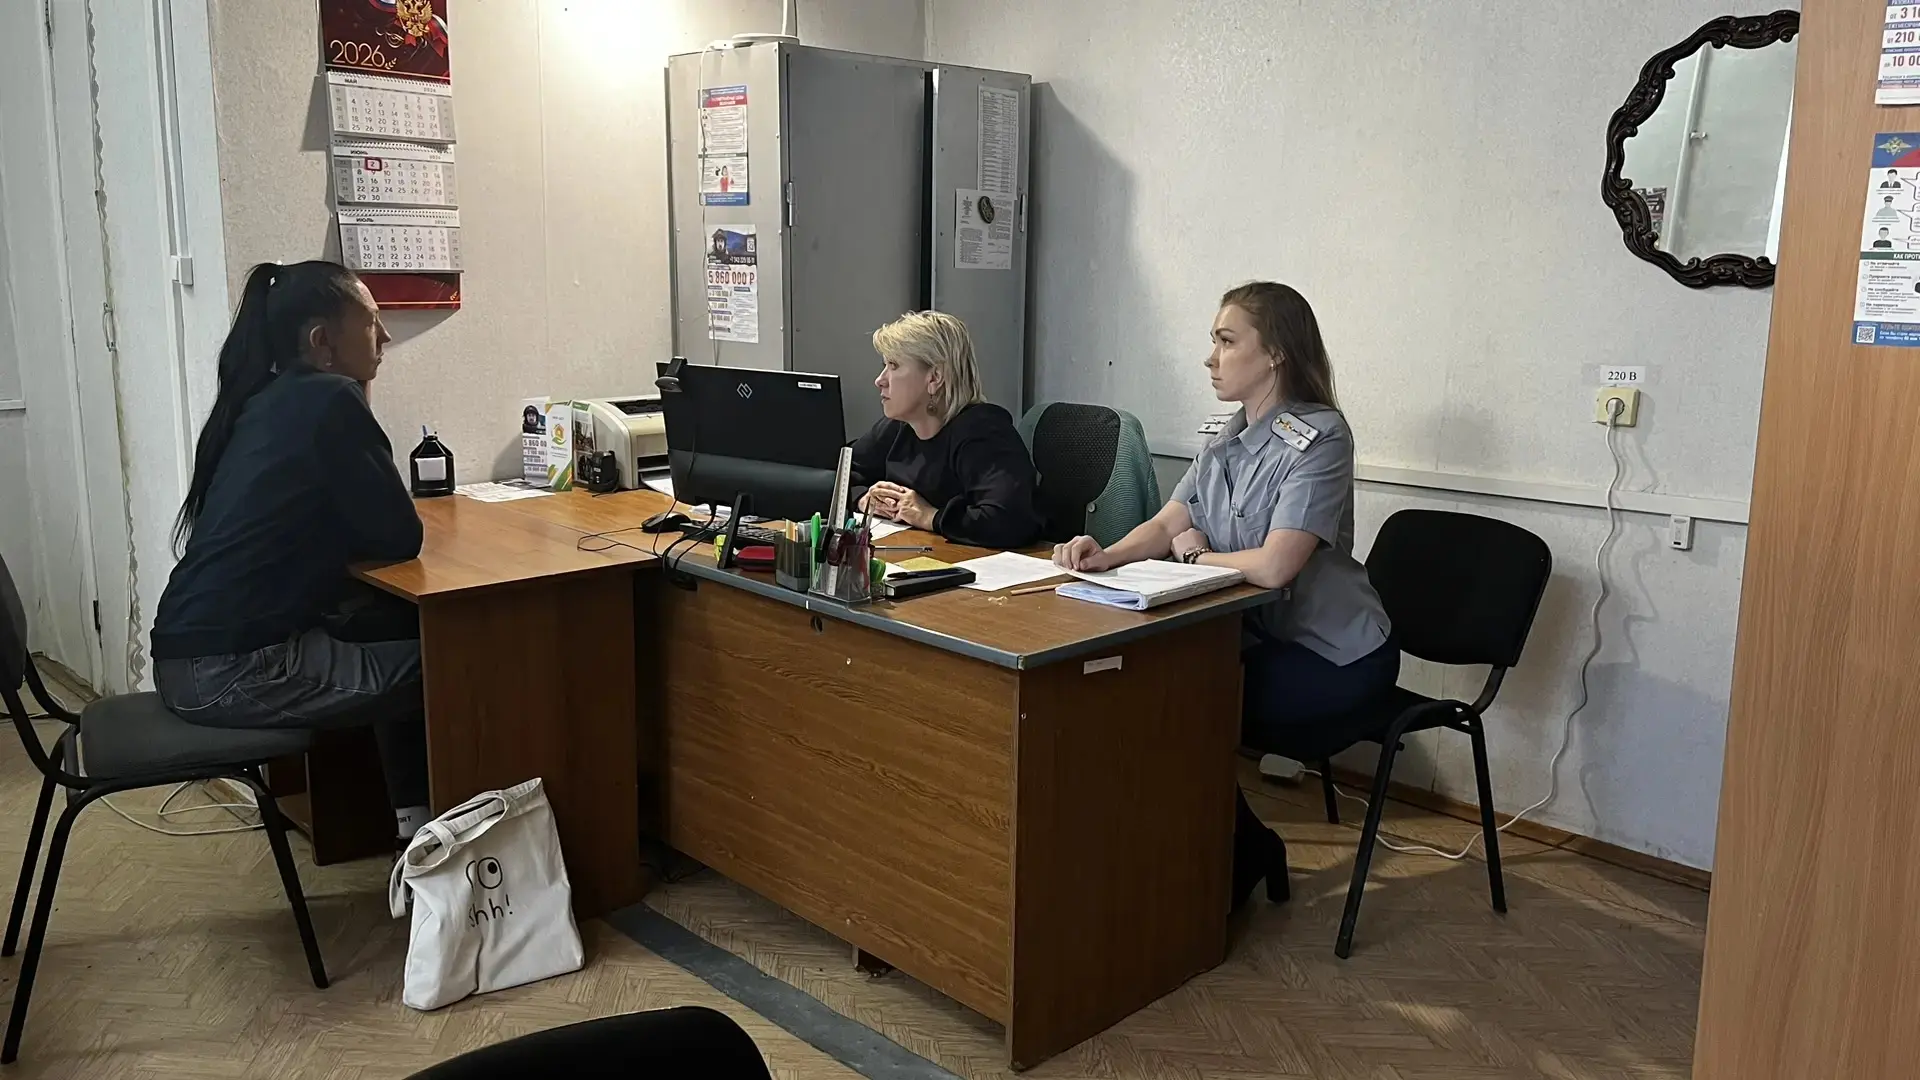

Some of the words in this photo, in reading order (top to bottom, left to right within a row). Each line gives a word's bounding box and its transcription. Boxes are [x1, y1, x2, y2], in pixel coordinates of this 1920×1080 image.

[1901, 7, 1908, 18] 3
[1895, 32, 1914, 43] 210
[330, 40, 385, 67] 2026
[1893, 56, 1904, 66] 10
[709, 271, 713, 283] 5
[716, 271, 729, 284] 860
[732, 272, 746, 285] 000
[1608, 371, 1626, 381] 220
[1630, 372, 1637, 381] В
